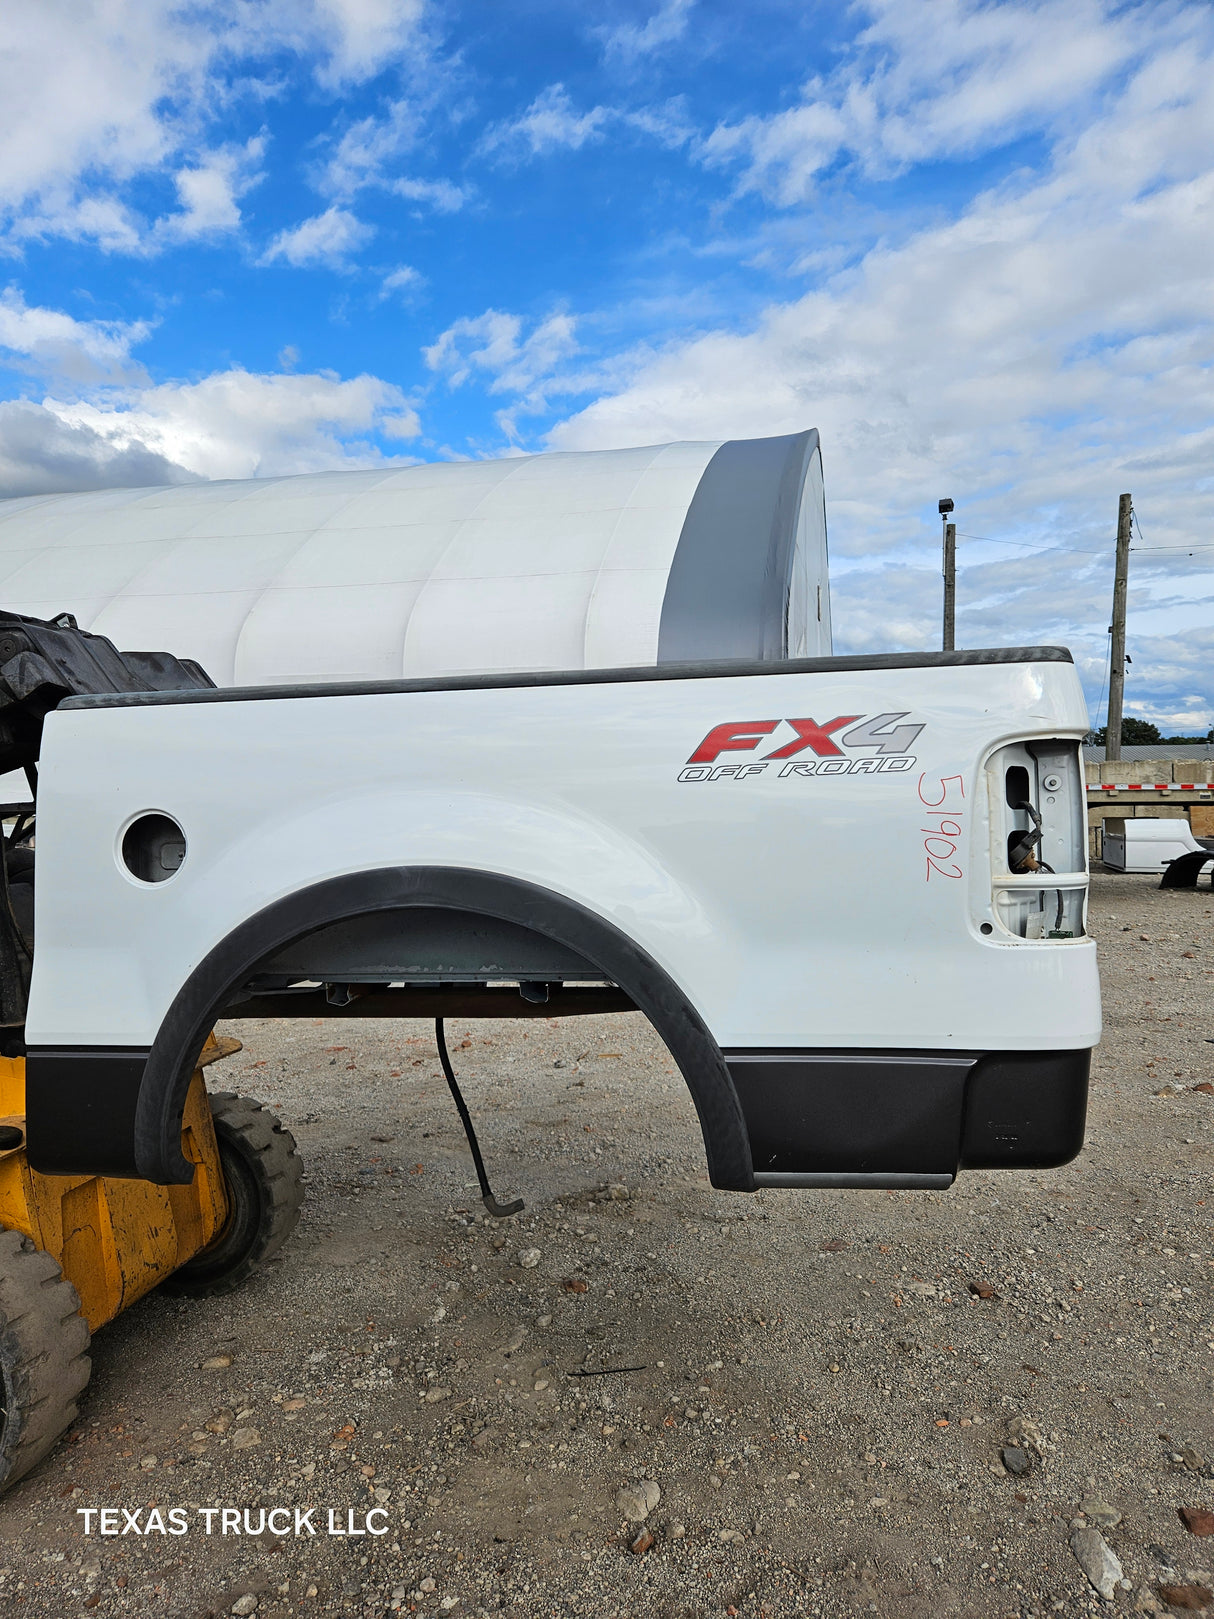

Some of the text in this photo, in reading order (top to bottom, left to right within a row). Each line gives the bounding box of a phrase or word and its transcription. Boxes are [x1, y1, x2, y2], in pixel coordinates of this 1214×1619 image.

[686, 711, 927, 764] FX4
[677, 755, 917, 783] OFF ROAD
[918, 771, 965, 882] 51902
